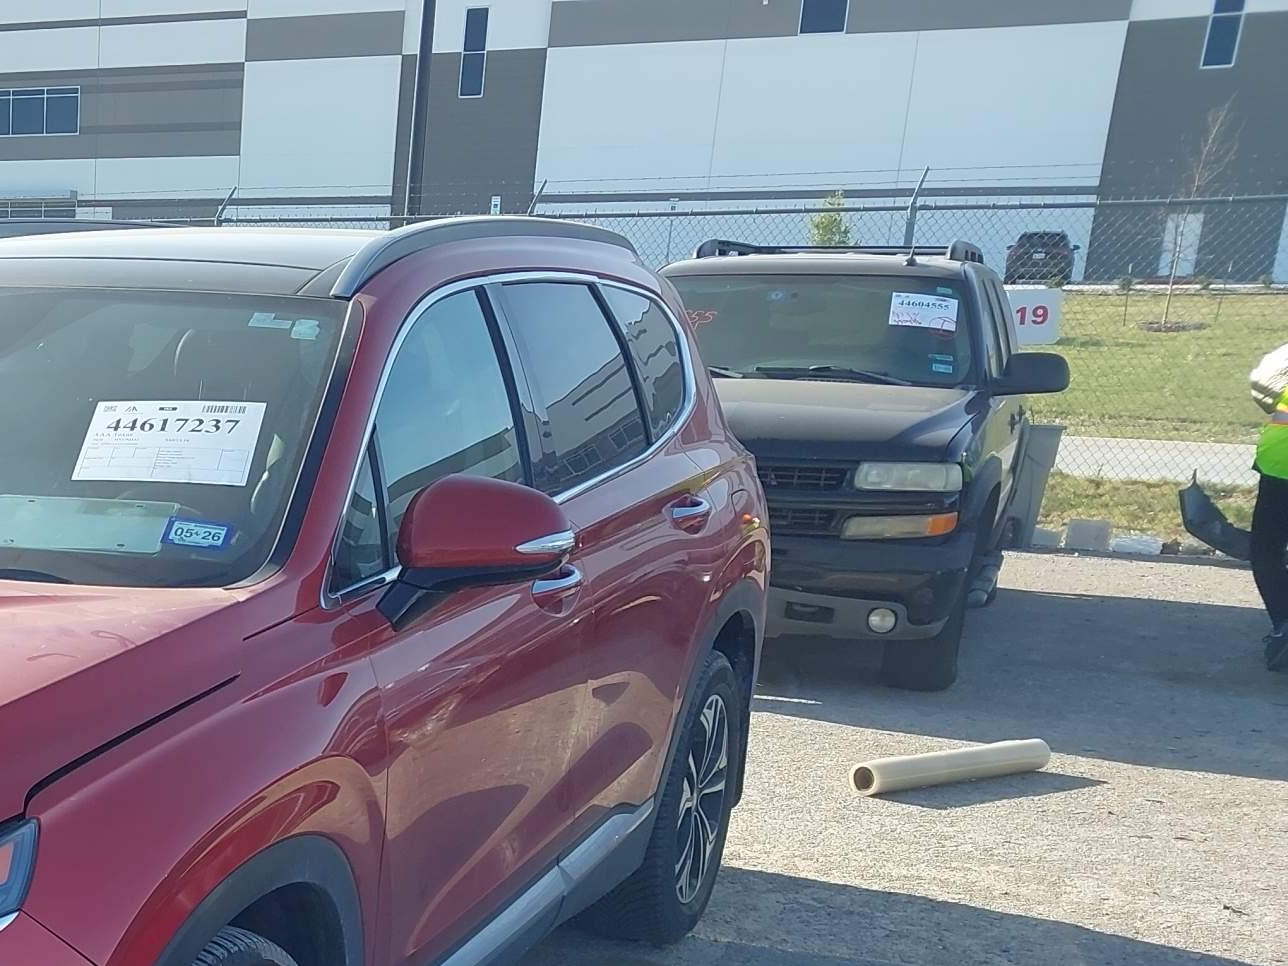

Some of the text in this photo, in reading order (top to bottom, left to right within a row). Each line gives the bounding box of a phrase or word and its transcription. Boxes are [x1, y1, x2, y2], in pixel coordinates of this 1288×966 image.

[898, 300, 950, 311] 44604555
[1015, 304, 1049, 325] 19
[106, 417, 241, 434] 44617237
[174, 526, 223, 542] 05 26
